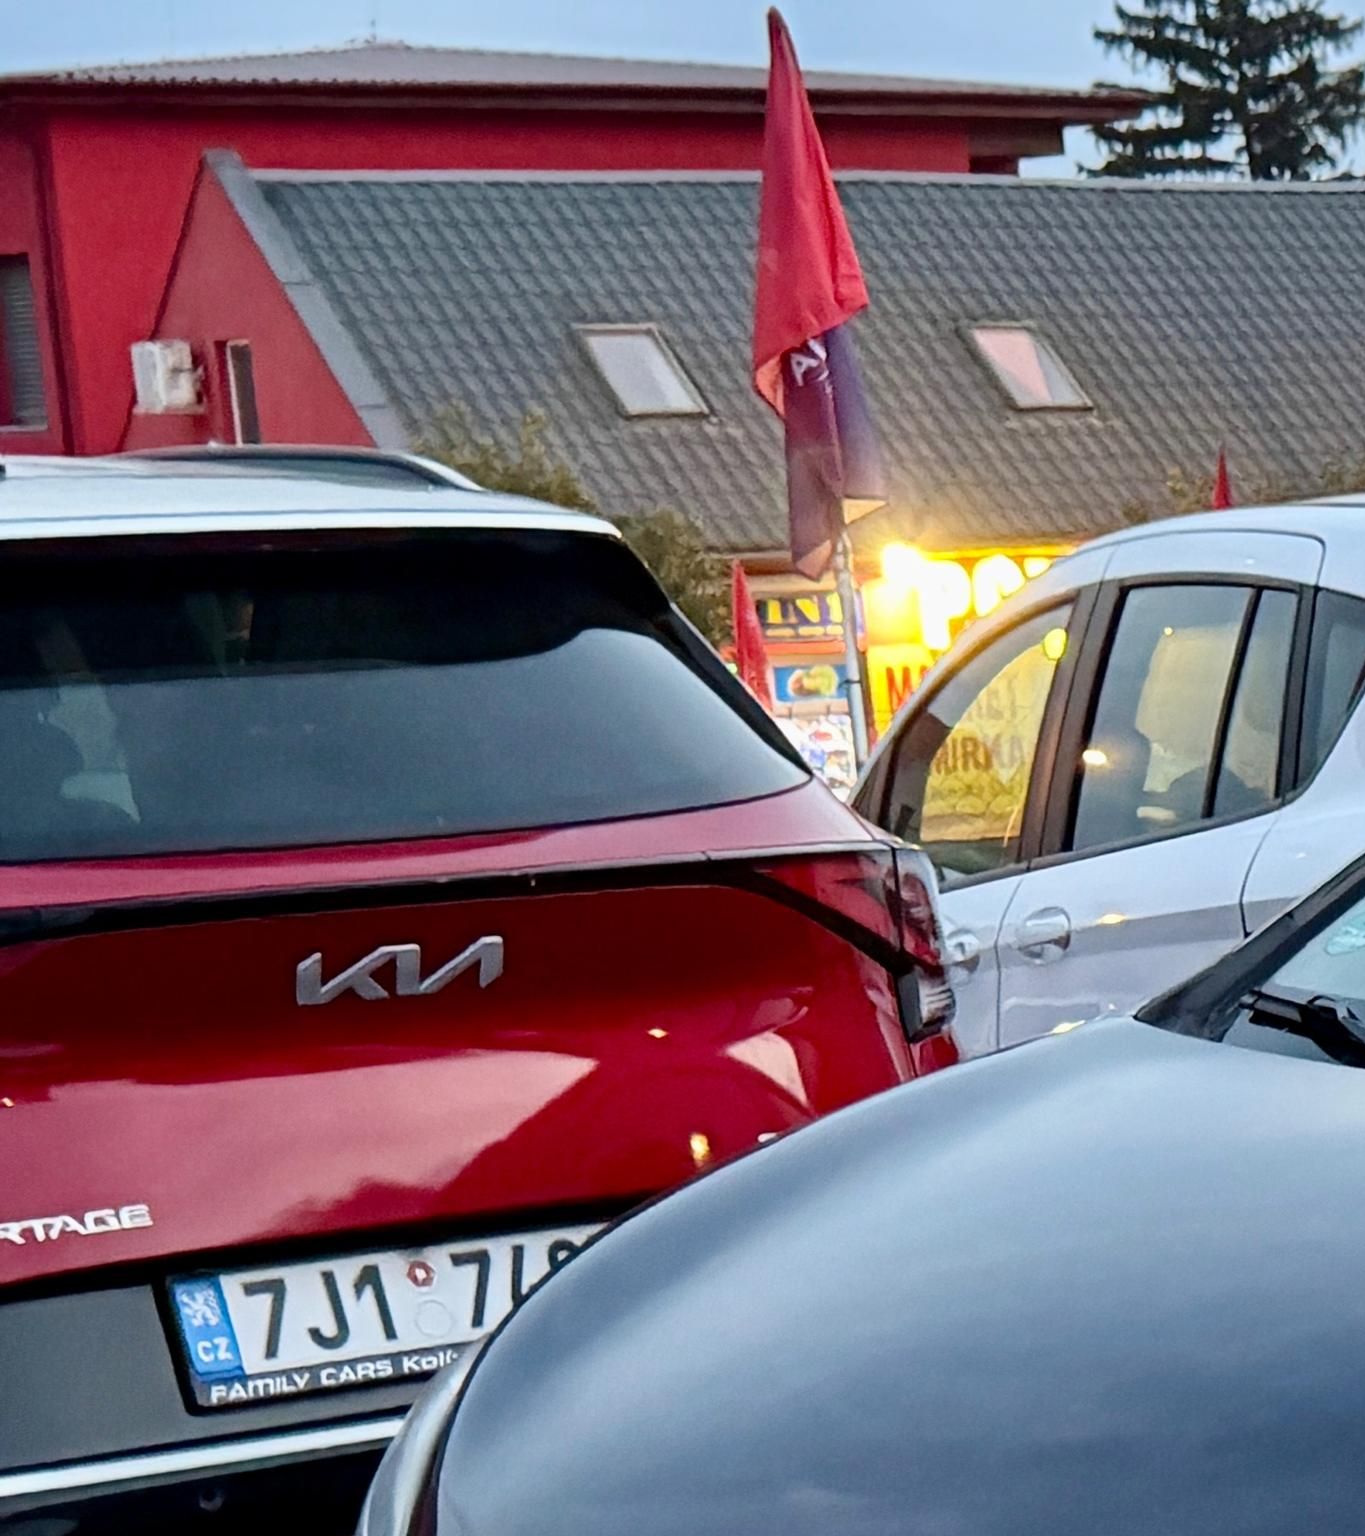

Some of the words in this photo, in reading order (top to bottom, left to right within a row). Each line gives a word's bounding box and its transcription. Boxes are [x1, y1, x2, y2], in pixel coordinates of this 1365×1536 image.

[296, 935, 504, 1006] KIA
[243, 1264, 398, 1361] 7J1
[198, 1336, 232, 1364] CZ
[208, 1372, 310, 1404] FAMILY
[320, 1352, 393, 1386] CARS
